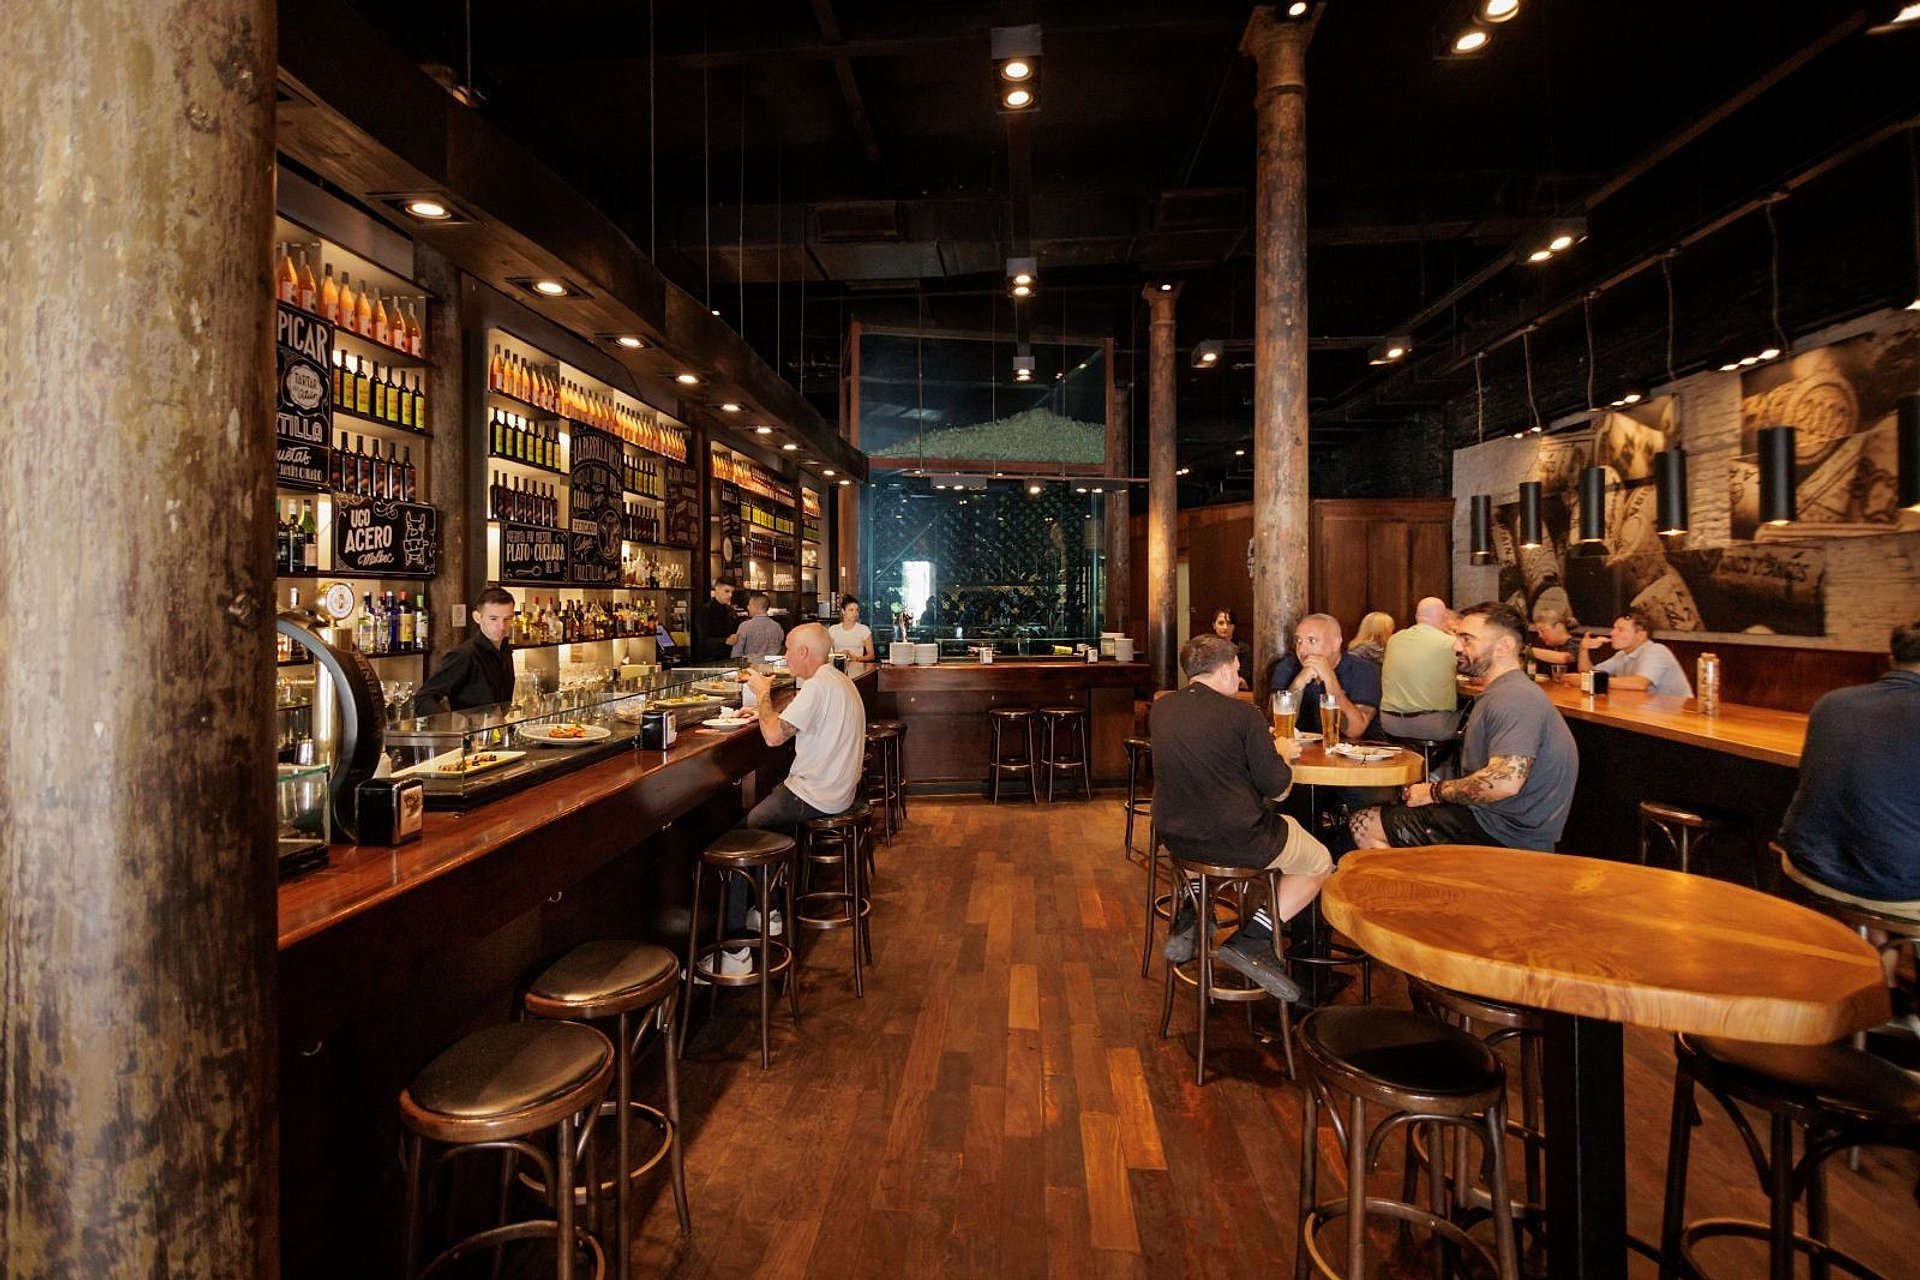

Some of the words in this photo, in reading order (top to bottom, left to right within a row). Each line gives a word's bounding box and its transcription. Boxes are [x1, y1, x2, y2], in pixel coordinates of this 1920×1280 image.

[277, 309, 328, 370] PICAR
[350, 508, 370, 528] UCO
[344, 525, 392, 553] ACERO
